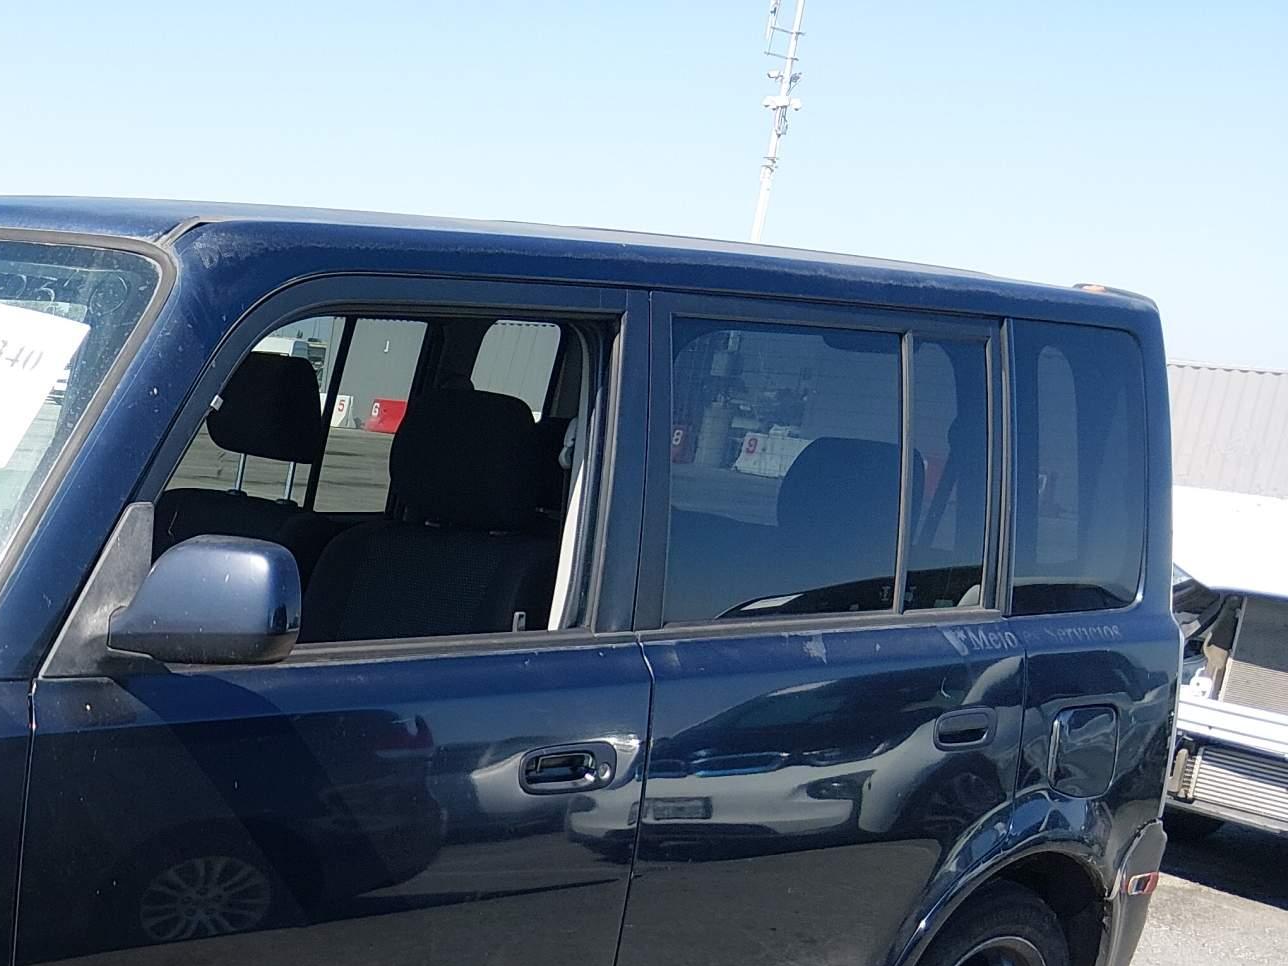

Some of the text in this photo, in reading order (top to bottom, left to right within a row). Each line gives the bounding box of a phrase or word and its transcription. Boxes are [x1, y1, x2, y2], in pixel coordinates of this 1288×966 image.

[372, 402, 380, 417] 6
[672, 429, 683, 445] 8
[745, 437, 758, 454] 9
